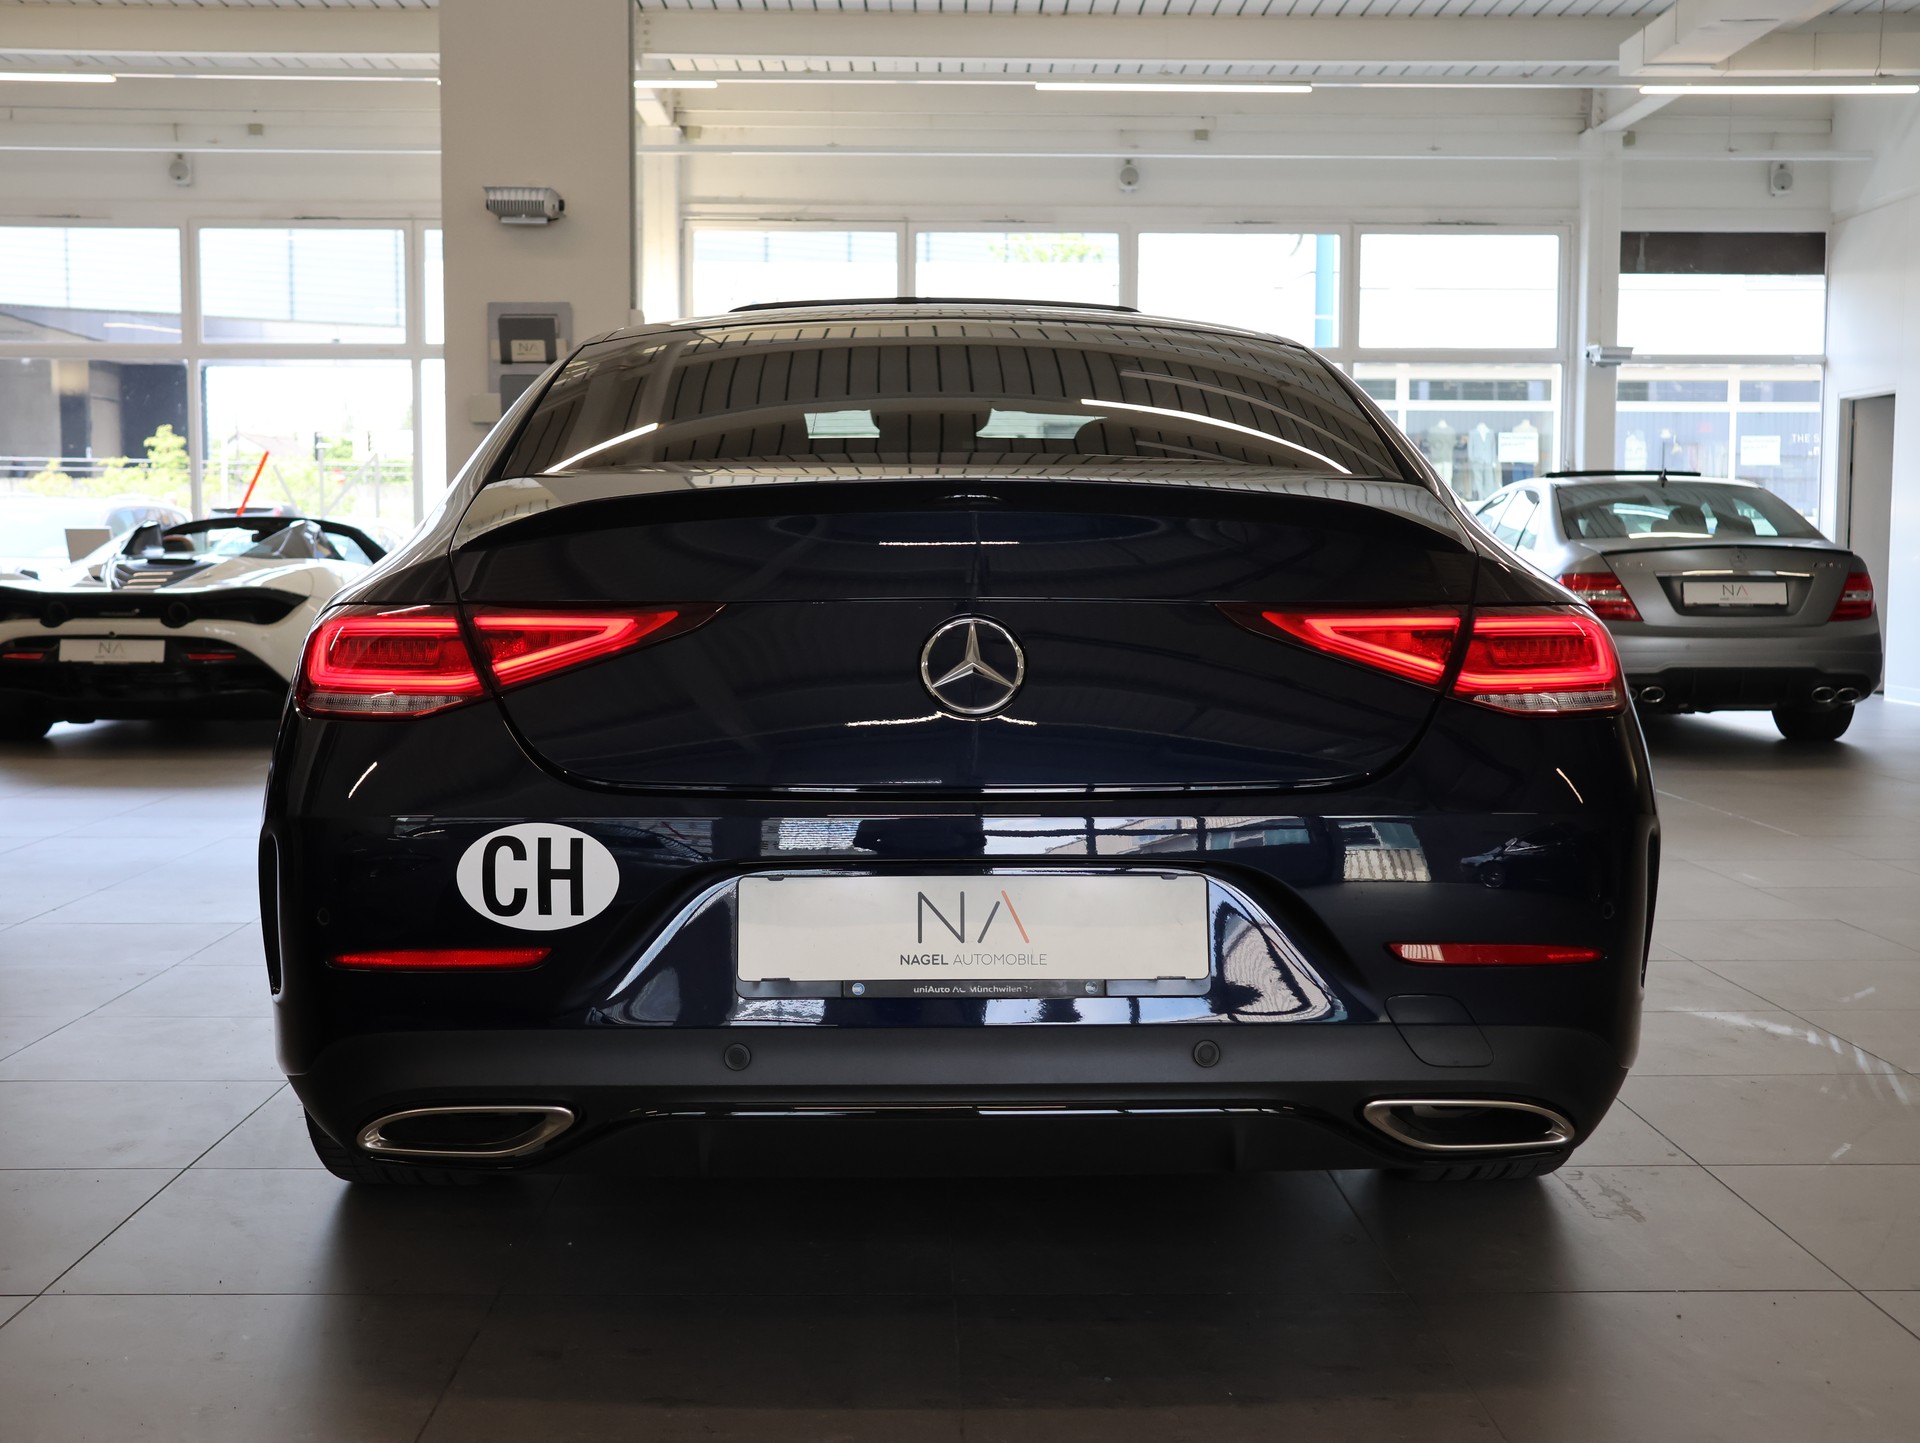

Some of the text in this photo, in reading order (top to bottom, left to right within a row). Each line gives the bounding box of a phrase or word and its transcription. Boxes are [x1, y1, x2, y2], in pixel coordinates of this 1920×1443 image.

[482, 835, 584, 918] CH
[917, 890, 1029, 944] NA
[900, 953, 1048, 966] NAGEL AUTOMOBILE
[913, 985, 950, 994] uniAuto
